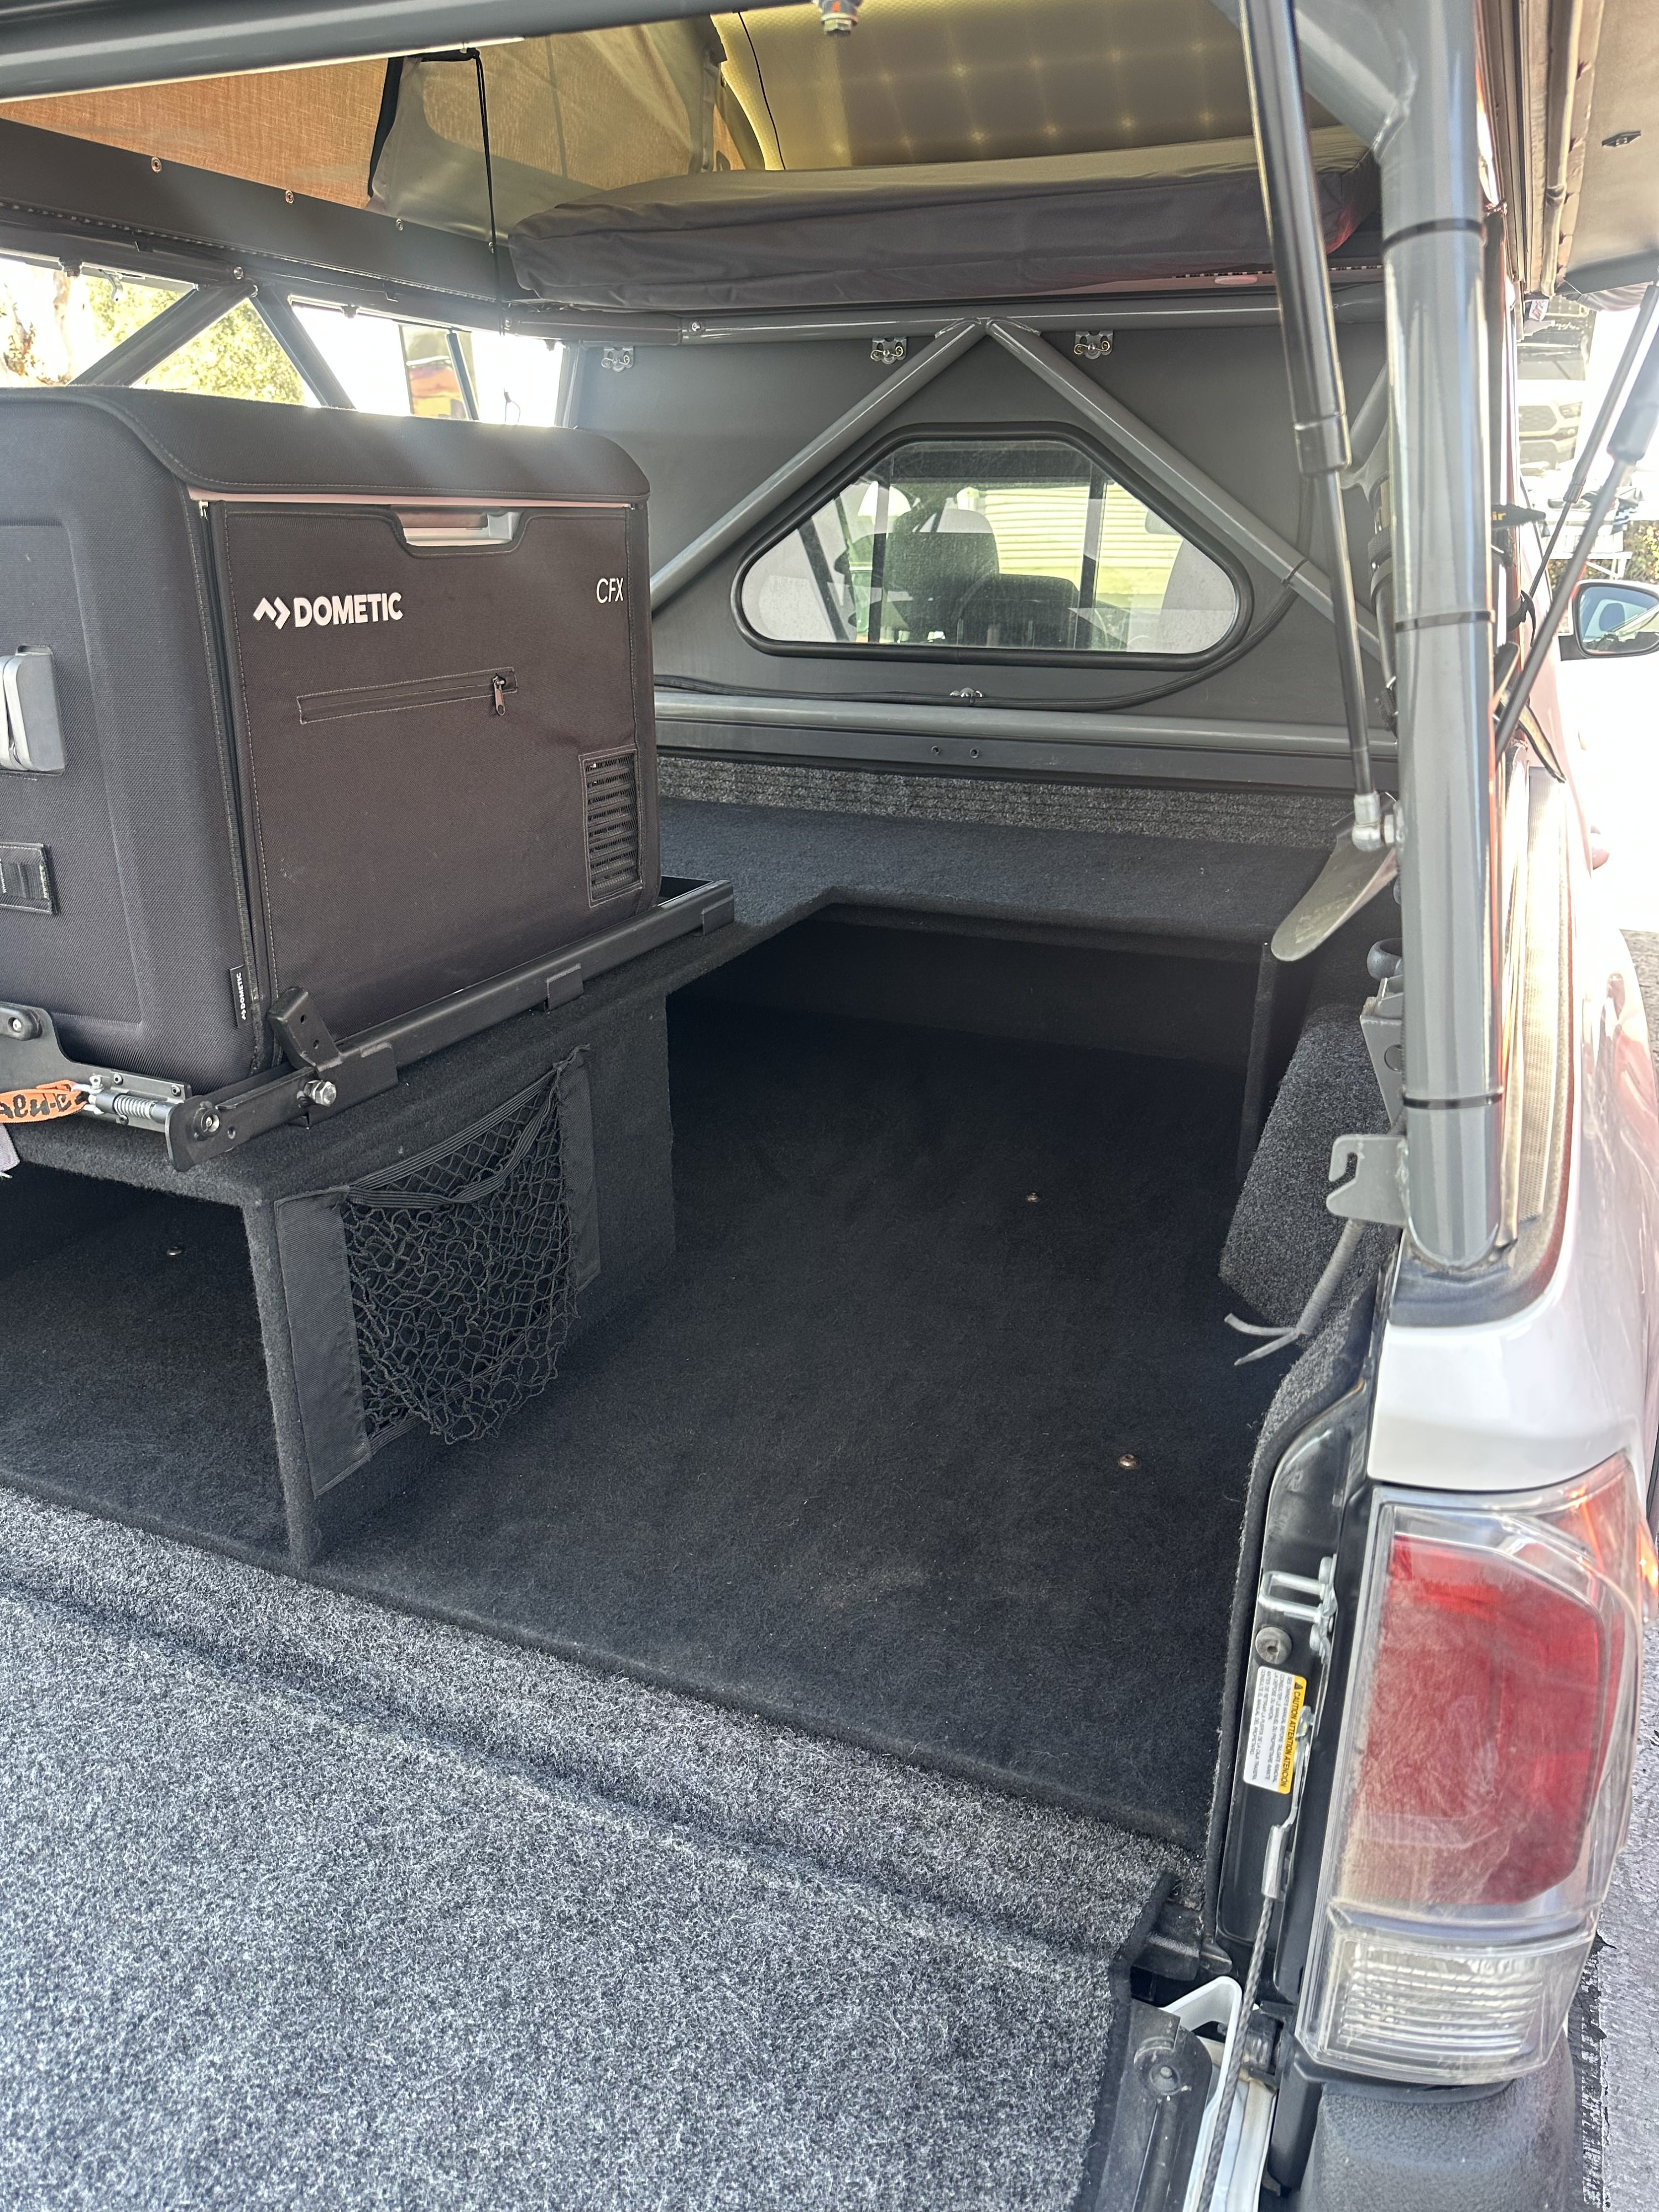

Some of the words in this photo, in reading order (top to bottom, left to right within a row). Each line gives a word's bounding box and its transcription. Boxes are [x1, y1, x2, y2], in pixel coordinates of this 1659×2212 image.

[595, 577, 624, 604] CFX
[294, 591, 404, 628] DOMETIC
[236, 972, 246, 1009] DOMETIC
[1290, 1691, 1301, 1720] CAUTION
[1285, 1720, 1296, 1755] ATTENTION
[1280, 1755, 1292, 1788] ATENCIÓN
